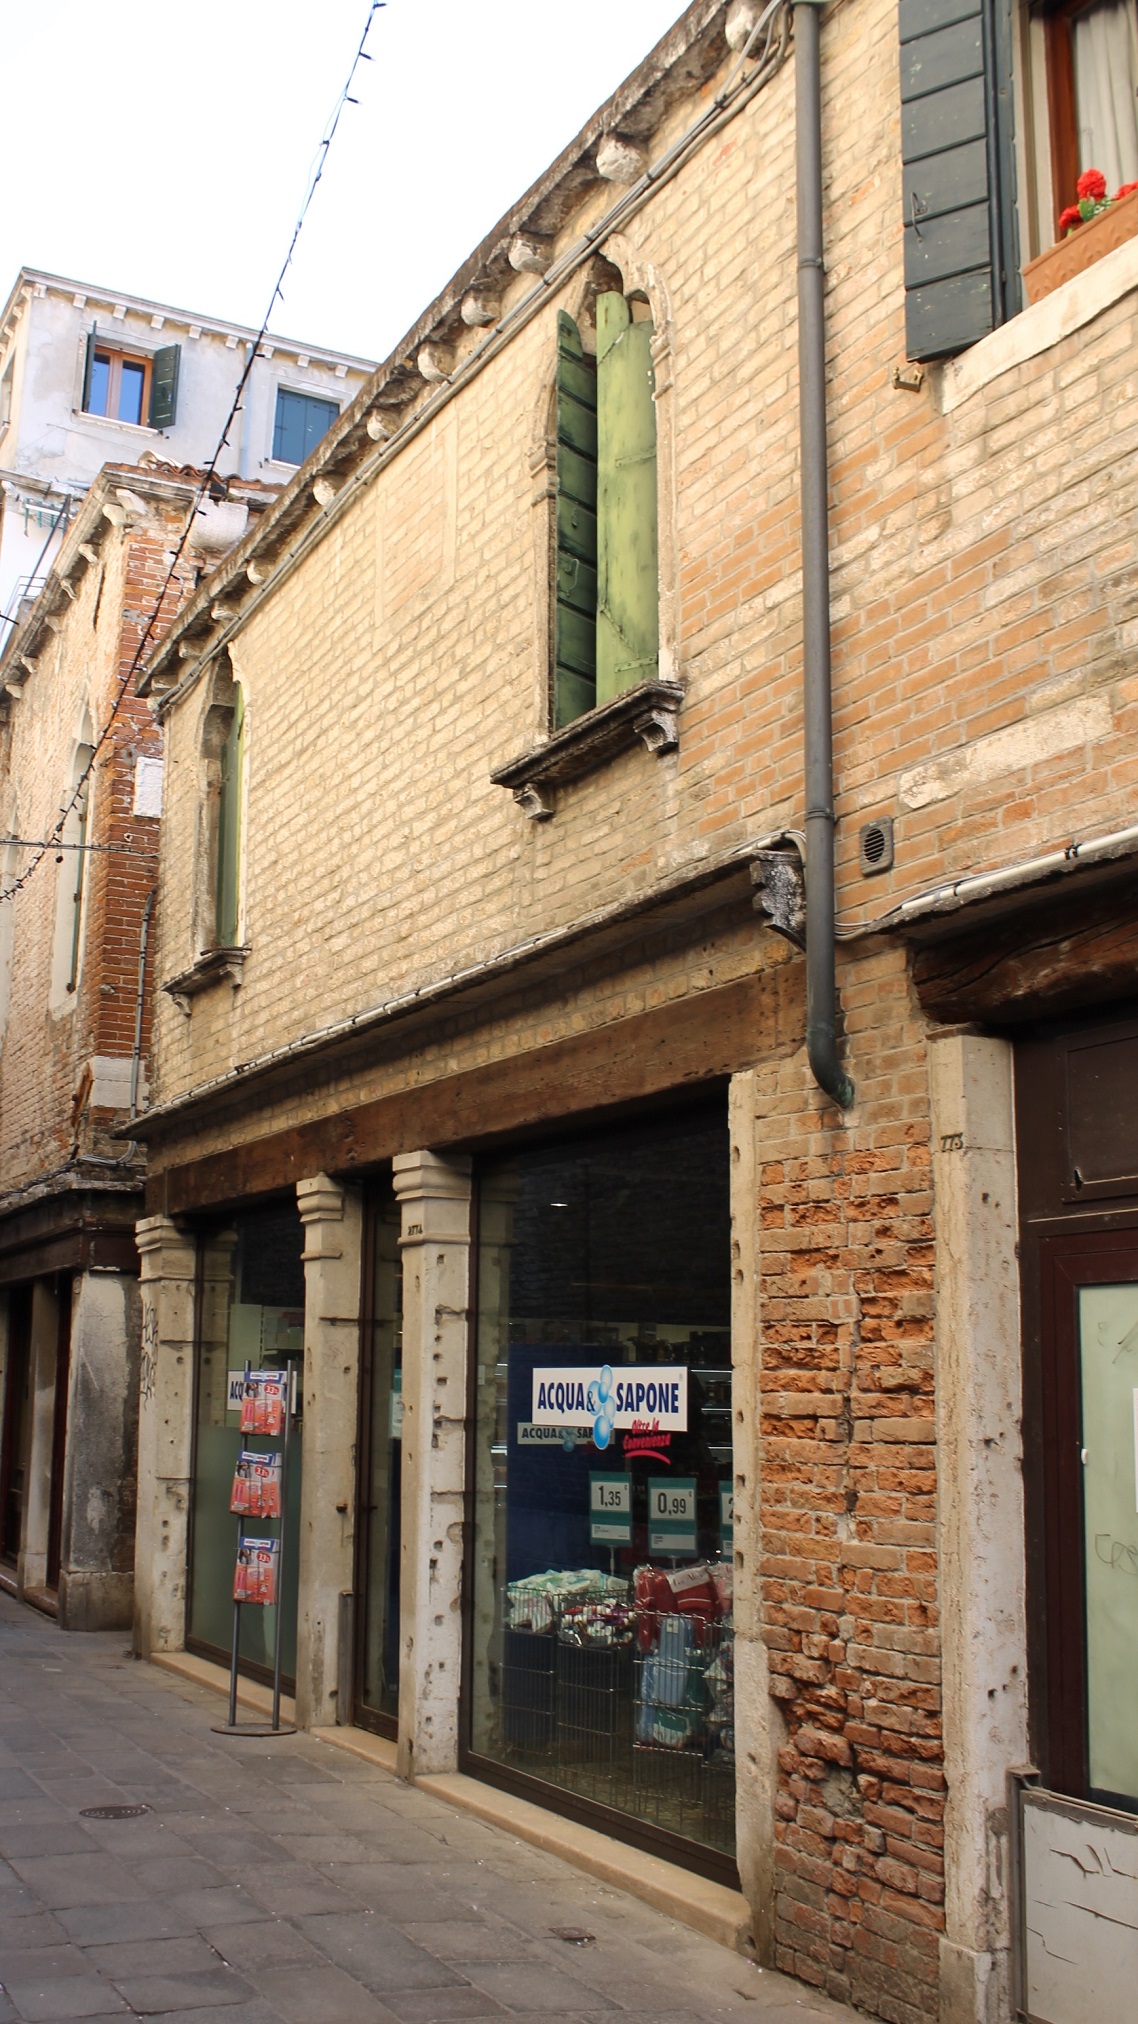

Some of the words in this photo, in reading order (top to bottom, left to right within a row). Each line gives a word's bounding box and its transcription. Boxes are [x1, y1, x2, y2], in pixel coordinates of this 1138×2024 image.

[229, 1381, 244, 1403] ACQ
[537, 1382, 585, 1414] ACQUA
[616, 1382, 679, 1413] SAPONE
[521, 1427, 557, 1440] ACQUA
[577, 1427, 593, 1439] SAP
[598, 1485, 622, 1507] 1,35
[657, 1492, 686, 1516] 0,99
